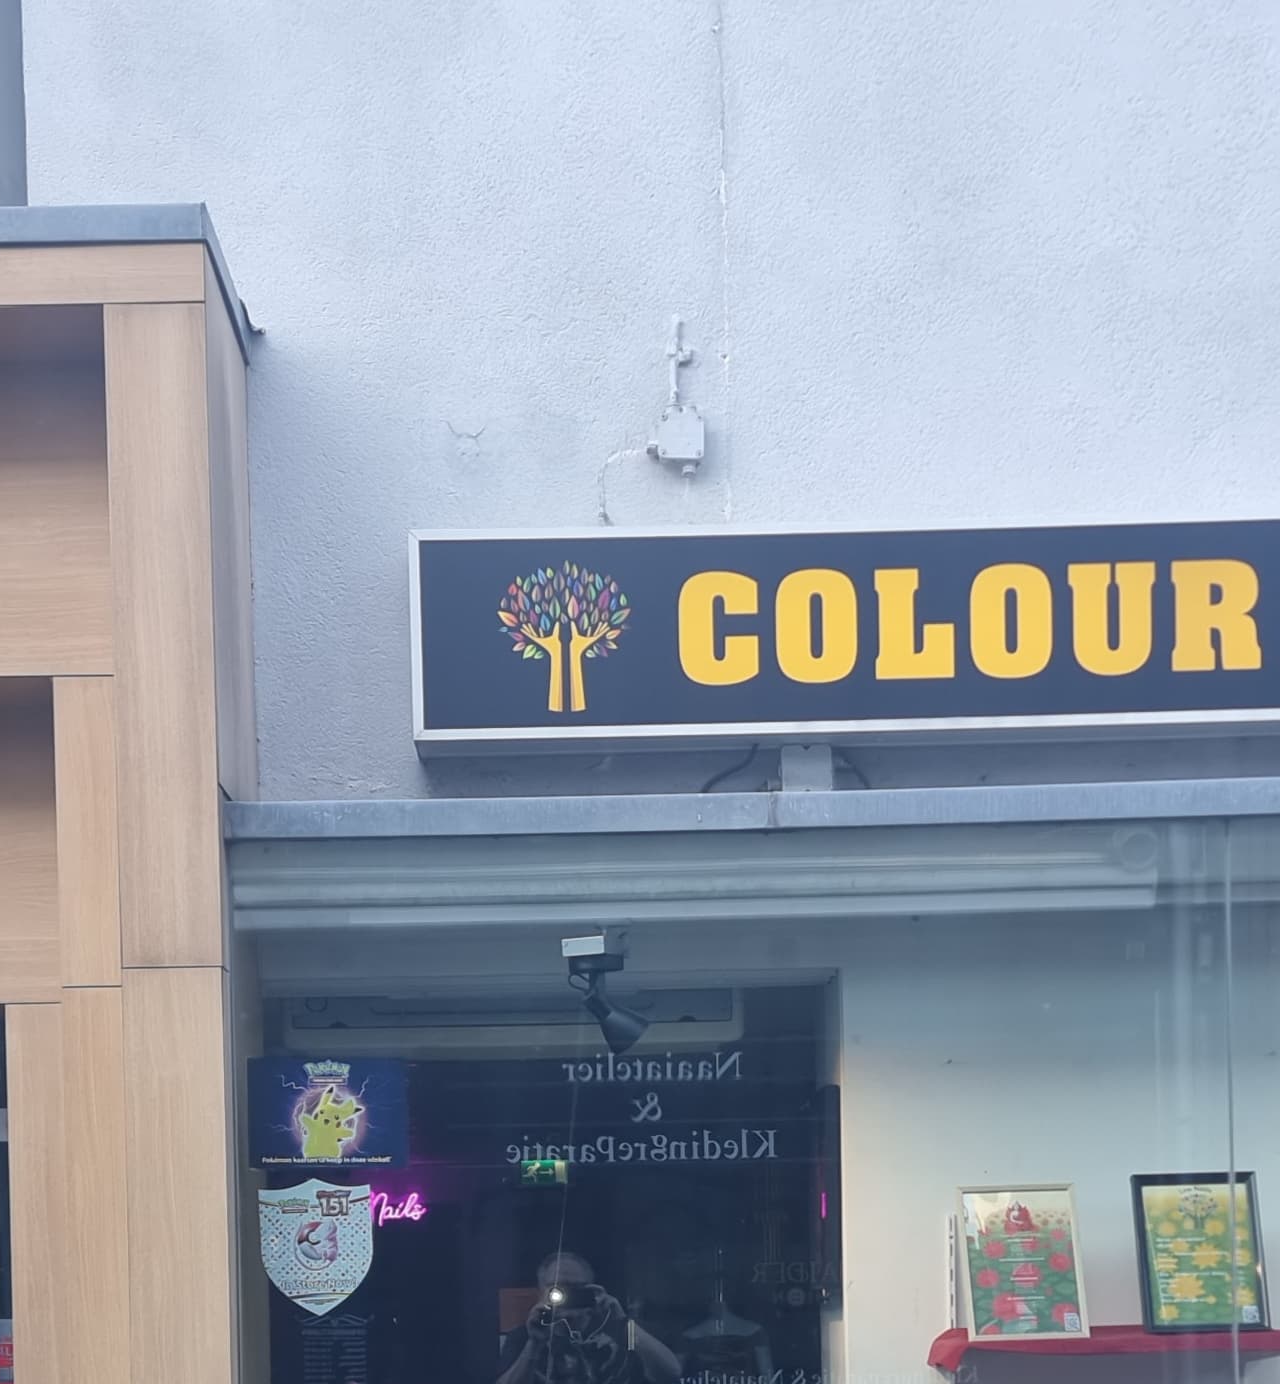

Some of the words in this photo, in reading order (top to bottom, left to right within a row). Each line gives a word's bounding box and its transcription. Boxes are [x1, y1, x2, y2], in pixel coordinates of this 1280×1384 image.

[678, 558, 1261, 685] COLOUR
[321, 1198, 349, 1216] 151
[371, 1192, 427, 1227] Nails
